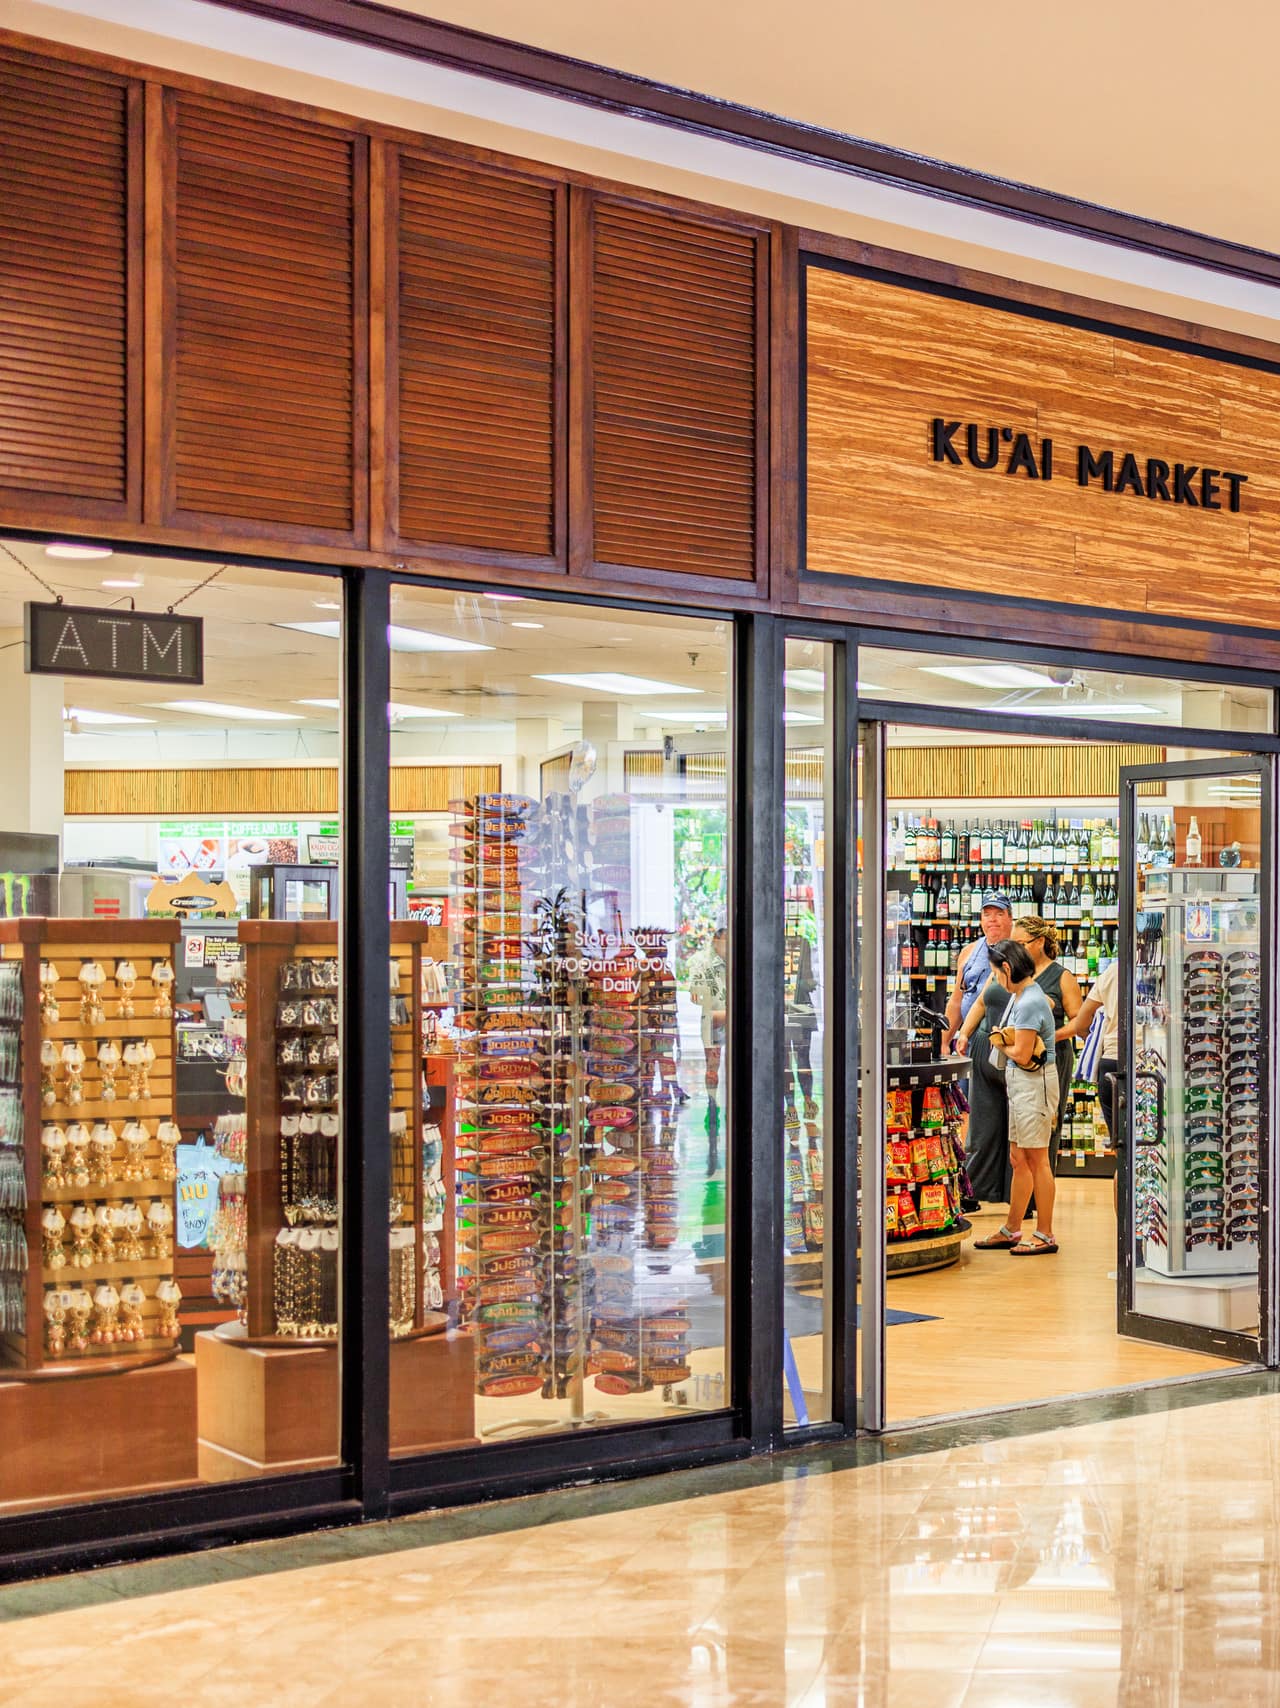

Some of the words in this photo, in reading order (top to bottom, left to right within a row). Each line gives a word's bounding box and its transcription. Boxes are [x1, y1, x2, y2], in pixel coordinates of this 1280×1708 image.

[1077, 445, 1249, 513] MARKET
[51, 616, 183, 673] ATM
[575, 931, 616, 946] Store
[602, 977, 641, 994] Daily
[487, 1040, 536, 1051] JORDAN
[487, 1062, 532, 1074] JORDYN
[487, 1112, 536, 1125] JOSEPH
[592, 1109, 628, 1121] ERIN
[491, 1184, 532, 1200] JUAN
[488, 1211, 533, 1223] JULIA
[490, 1256, 534, 1273] JUSTIN
[489, 1354, 535, 1370] KALEB
